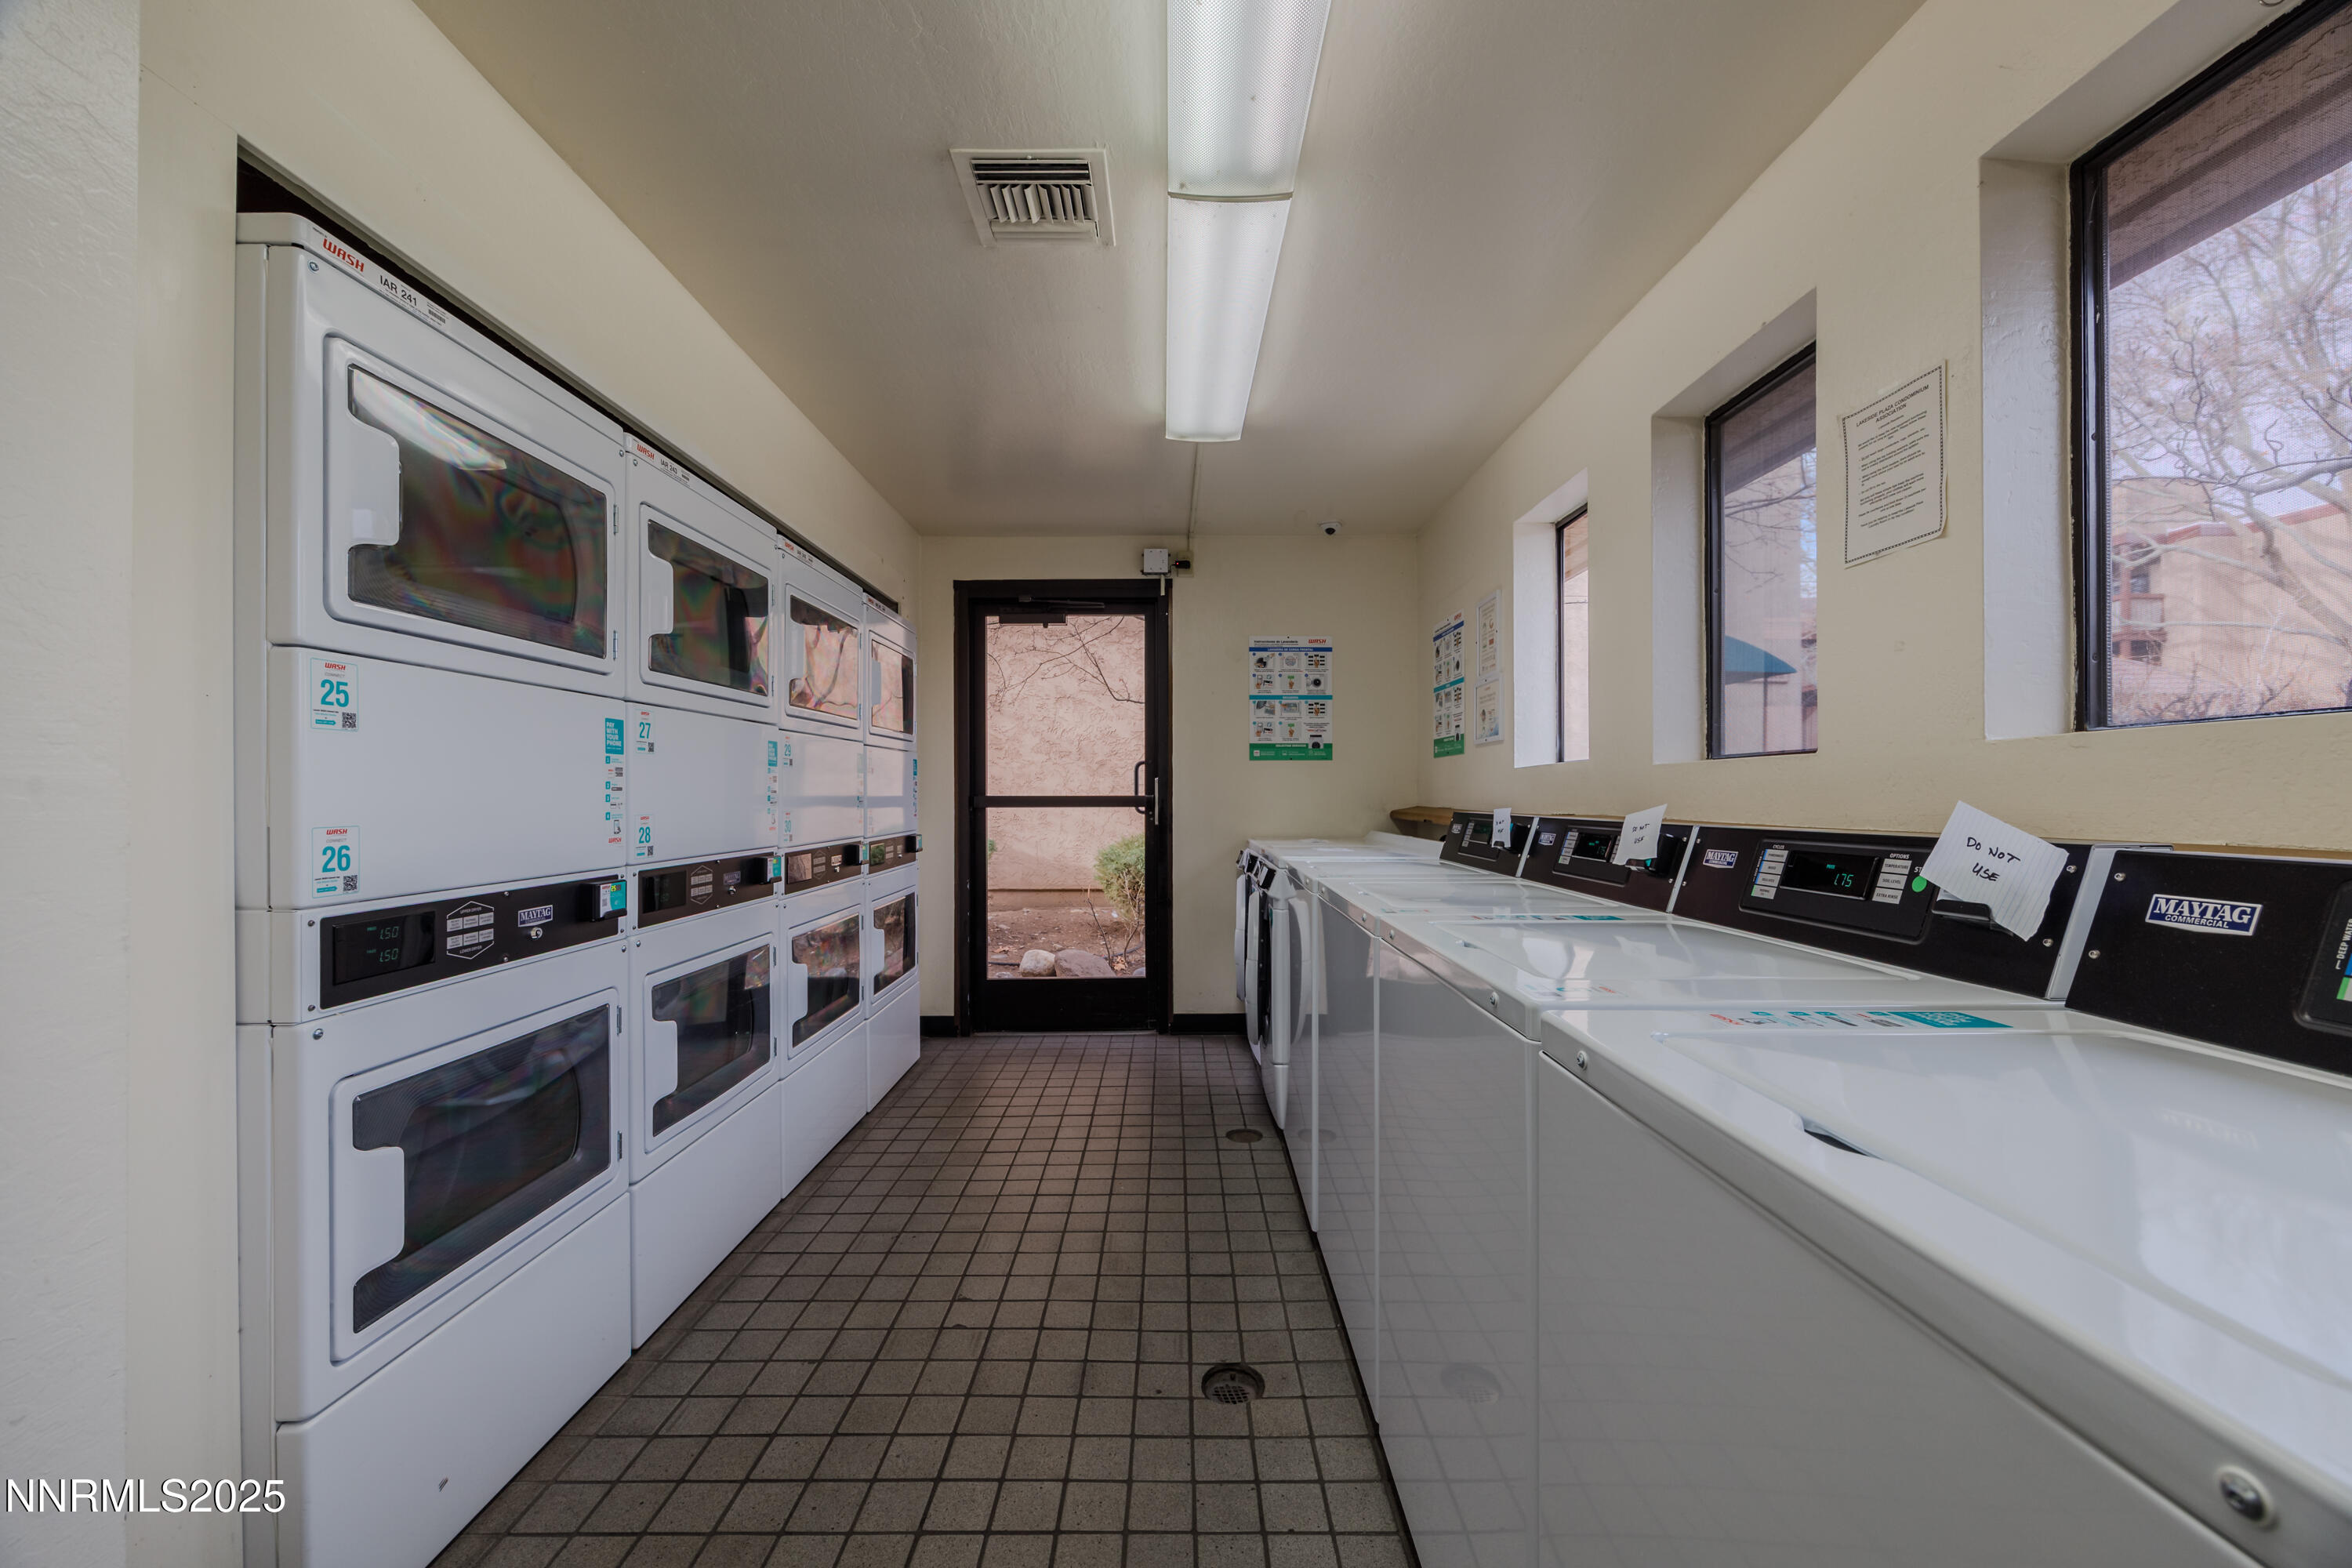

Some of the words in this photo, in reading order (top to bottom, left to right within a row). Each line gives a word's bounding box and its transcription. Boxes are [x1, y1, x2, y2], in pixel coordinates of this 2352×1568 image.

[322, 238, 365, 272] WASH
[379, 275, 397, 294] IAR
[401, 289, 417, 306] 241
[1856, 412, 1878, 427] LAKESIDE
[1878, 404, 1893, 415] PLAZA
[1894, 384, 1929, 406] CONDOMINIUM
[1875, 403, 1907, 423] ASSOCIATION
[637, 444, 655, 460] WASH
[321, 679, 349, 707] 25
[639, 721, 651, 739] 27
[784, 744, 792, 757] 29
[638, 826, 651, 844] 28
[322, 844, 350, 873] 26
[1706, 851, 1736, 862] MAYTAG
[1966, 837, 1981, 851] DO
[1987, 847, 2021, 863] NOT
[1972, 862, 2001, 882] USE
[521, 907, 551, 921] MAYTAG
[2154, 898, 2251, 924] MAYTAG
[2165, 914, 2229, 929] COMMERCIAL
[2336, 942, 2347, 960] DEEP
